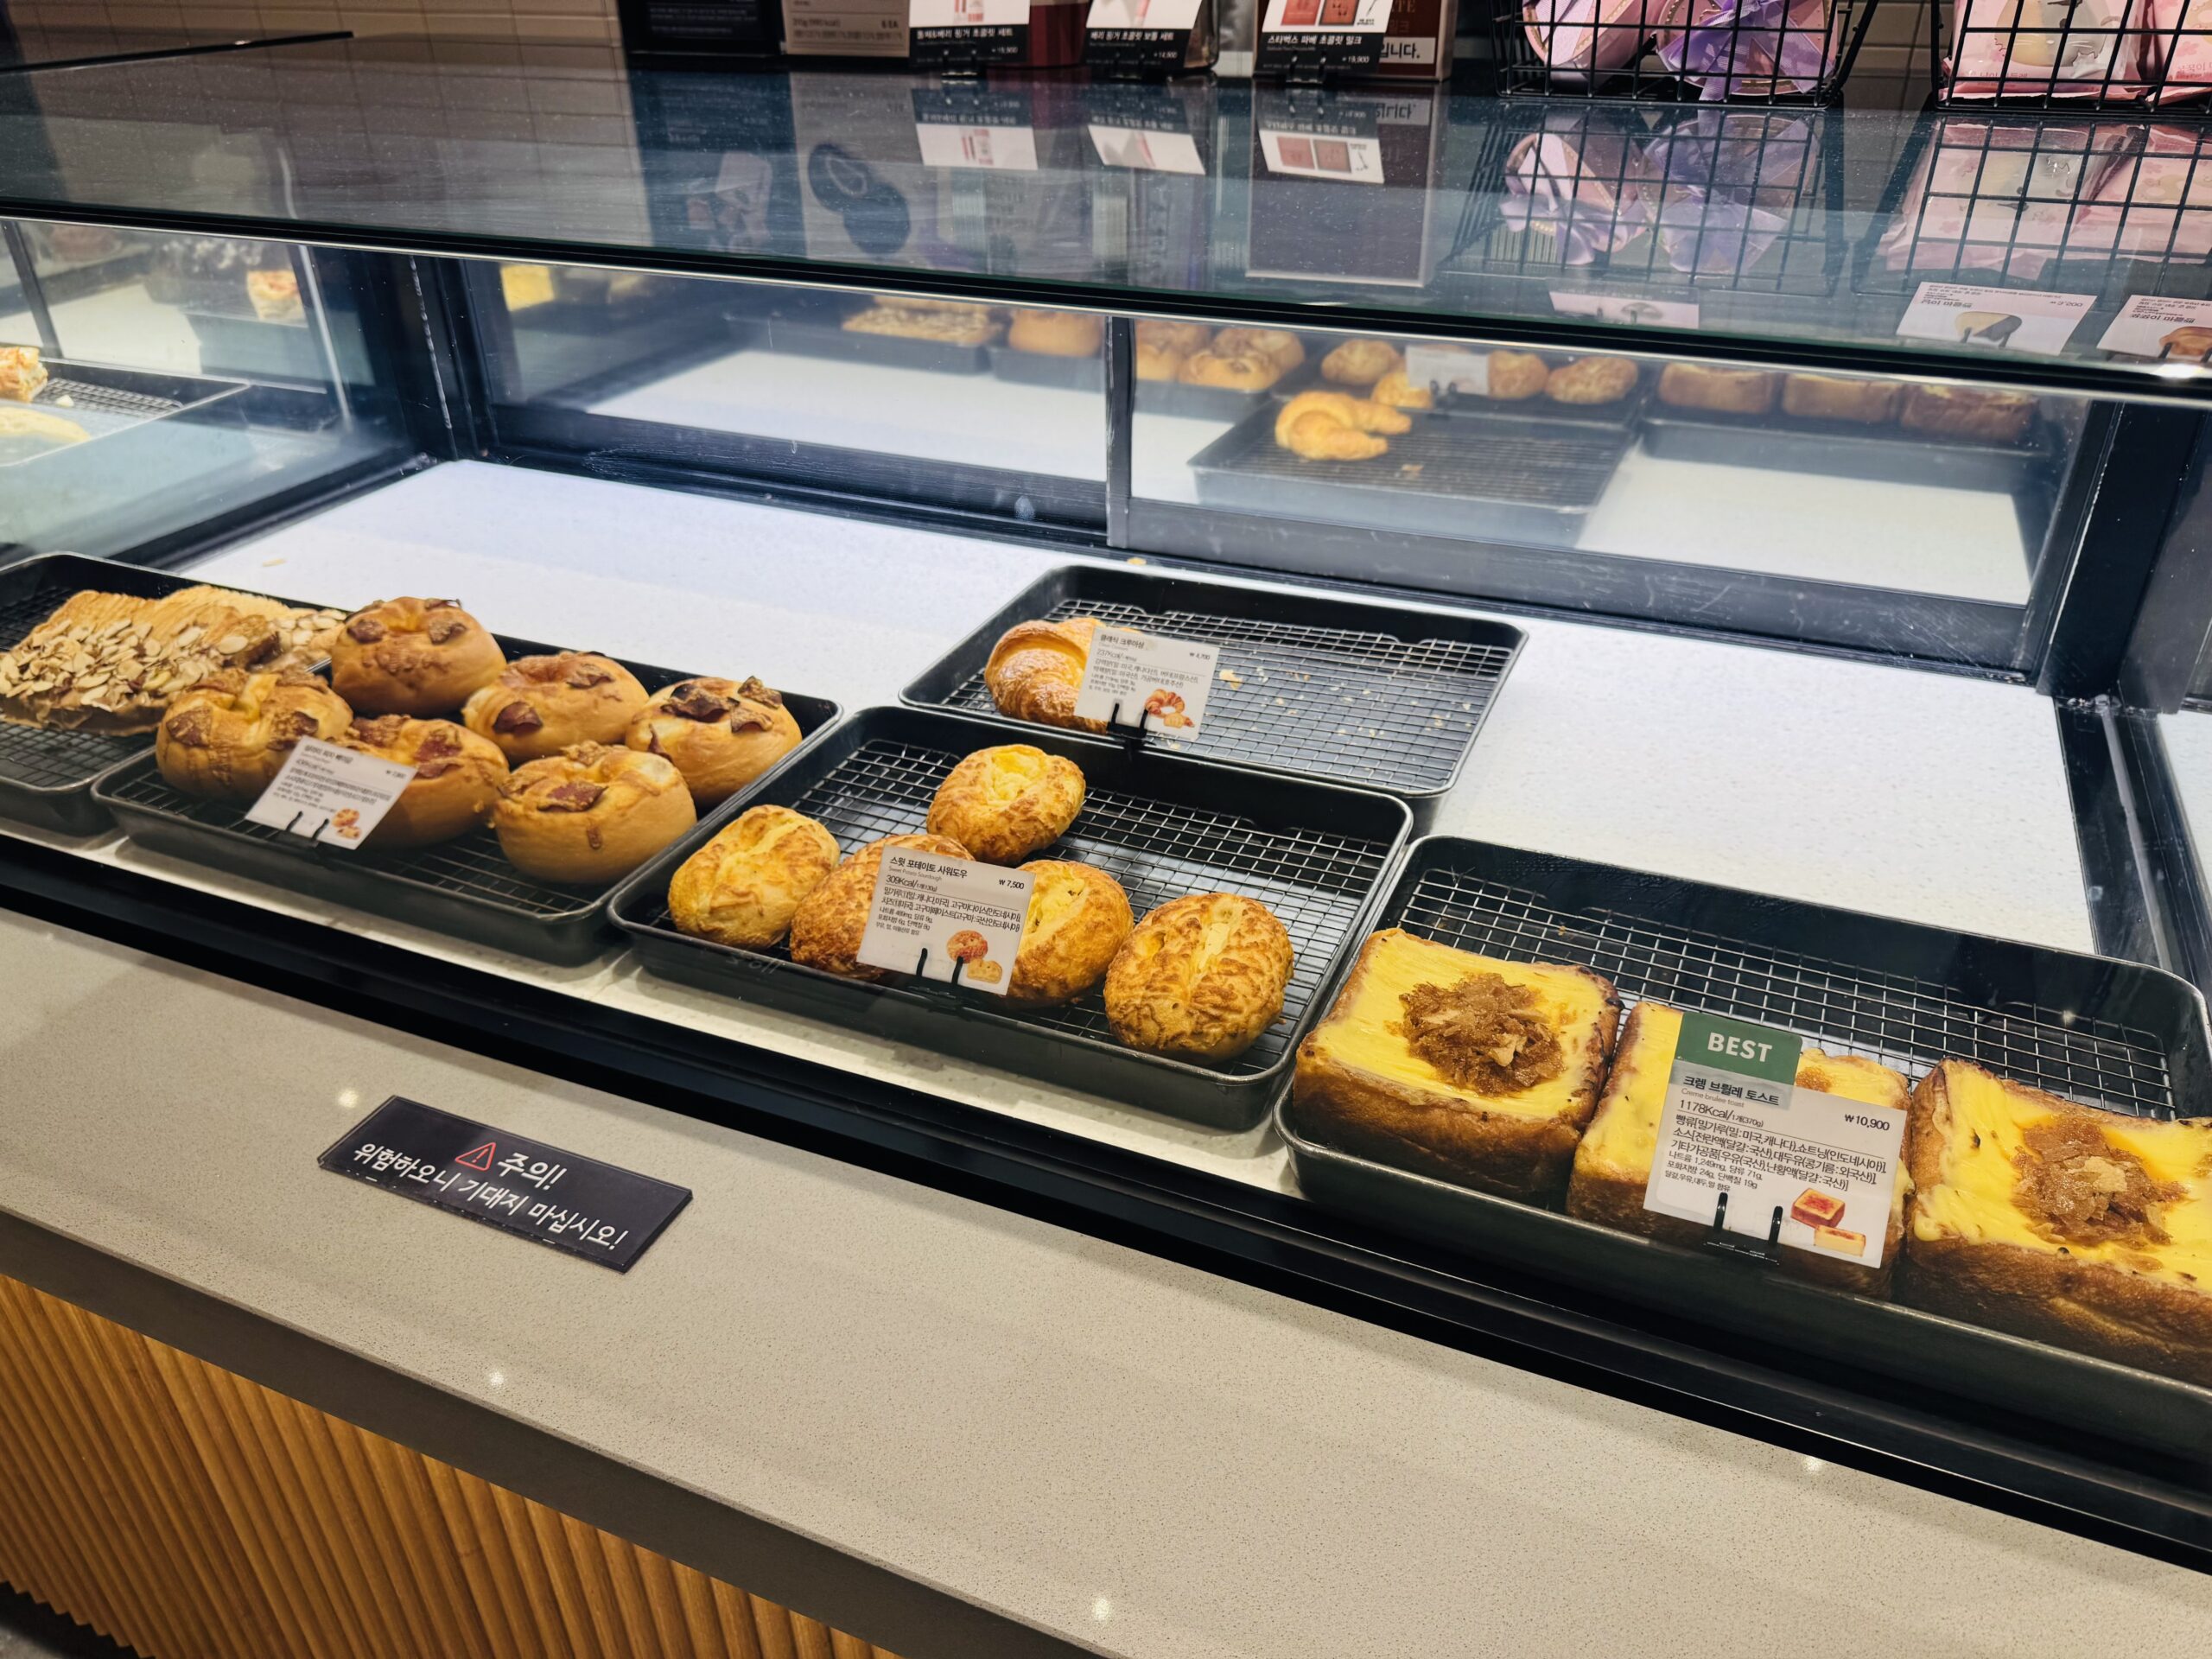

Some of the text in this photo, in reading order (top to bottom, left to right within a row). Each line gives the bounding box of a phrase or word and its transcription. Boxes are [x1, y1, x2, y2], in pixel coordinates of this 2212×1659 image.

[1267, 35, 1299, 44] 스타벅스
[1319, 35, 1344, 45] 초콜릿
[1345, 35, 1362, 45] 밀크
[890, 856, 968, 878] 스윗 포테이토 사워도우
[1707, 1033, 1773, 1063] BEST
[1683, 1076, 1780, 1106] 크렘 브륄레 토스트
[497, 1152, 567, 1191] 주의!
[1667, 1160, 1697, 1174] 포화지방
[1718, 1173, 1741, 1185] 단백질
[1669, 1151, 1692, 1163] 나트륨
[1729, 1165, 1745, 1175] 당류
[354, 1143, 629, 1250] 위험하오니 기대지 마십시오!
[1717, 1183, 1731, 1192] 함유
